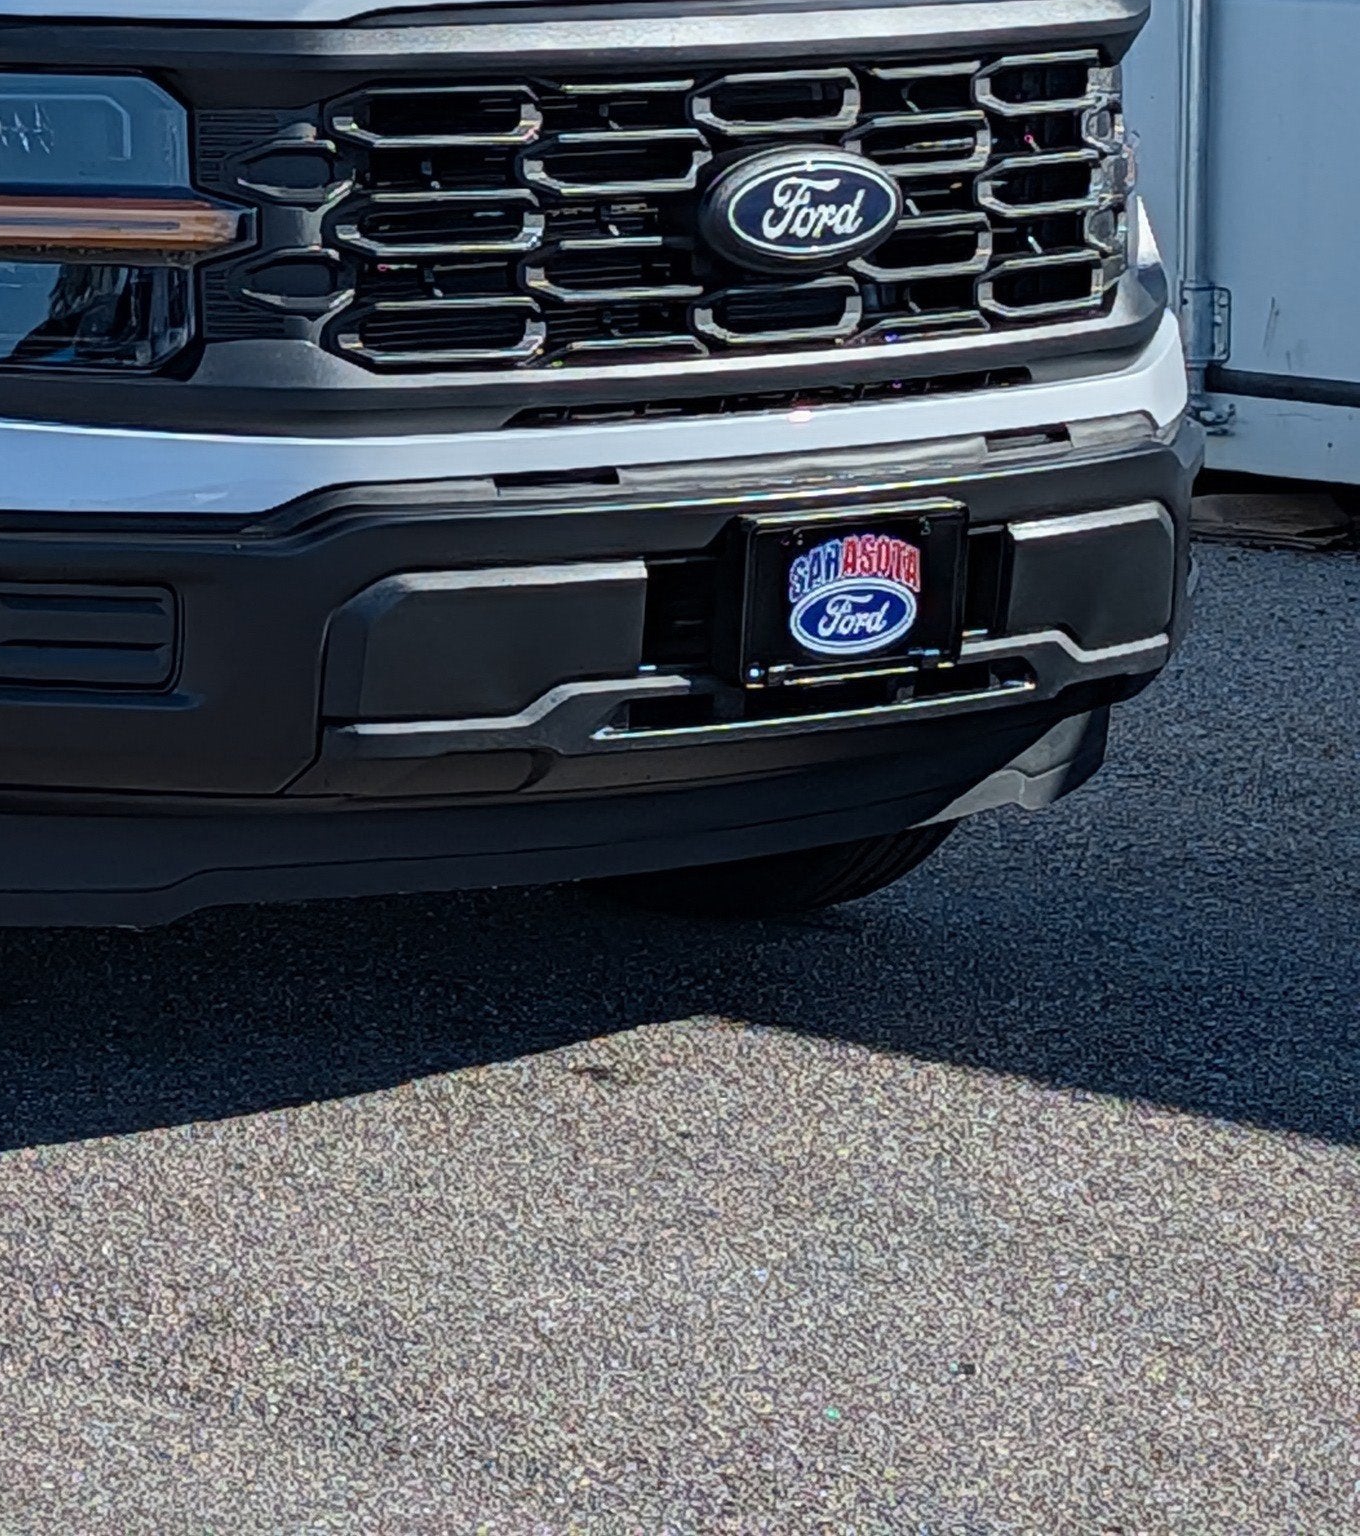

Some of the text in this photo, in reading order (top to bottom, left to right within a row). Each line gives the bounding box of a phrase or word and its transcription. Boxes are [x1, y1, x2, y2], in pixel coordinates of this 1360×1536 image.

[762, 176, 866, 240] Ford
[789, 533, 921, 603] SARASOTA
[817, 594, 890, 638] Ford
